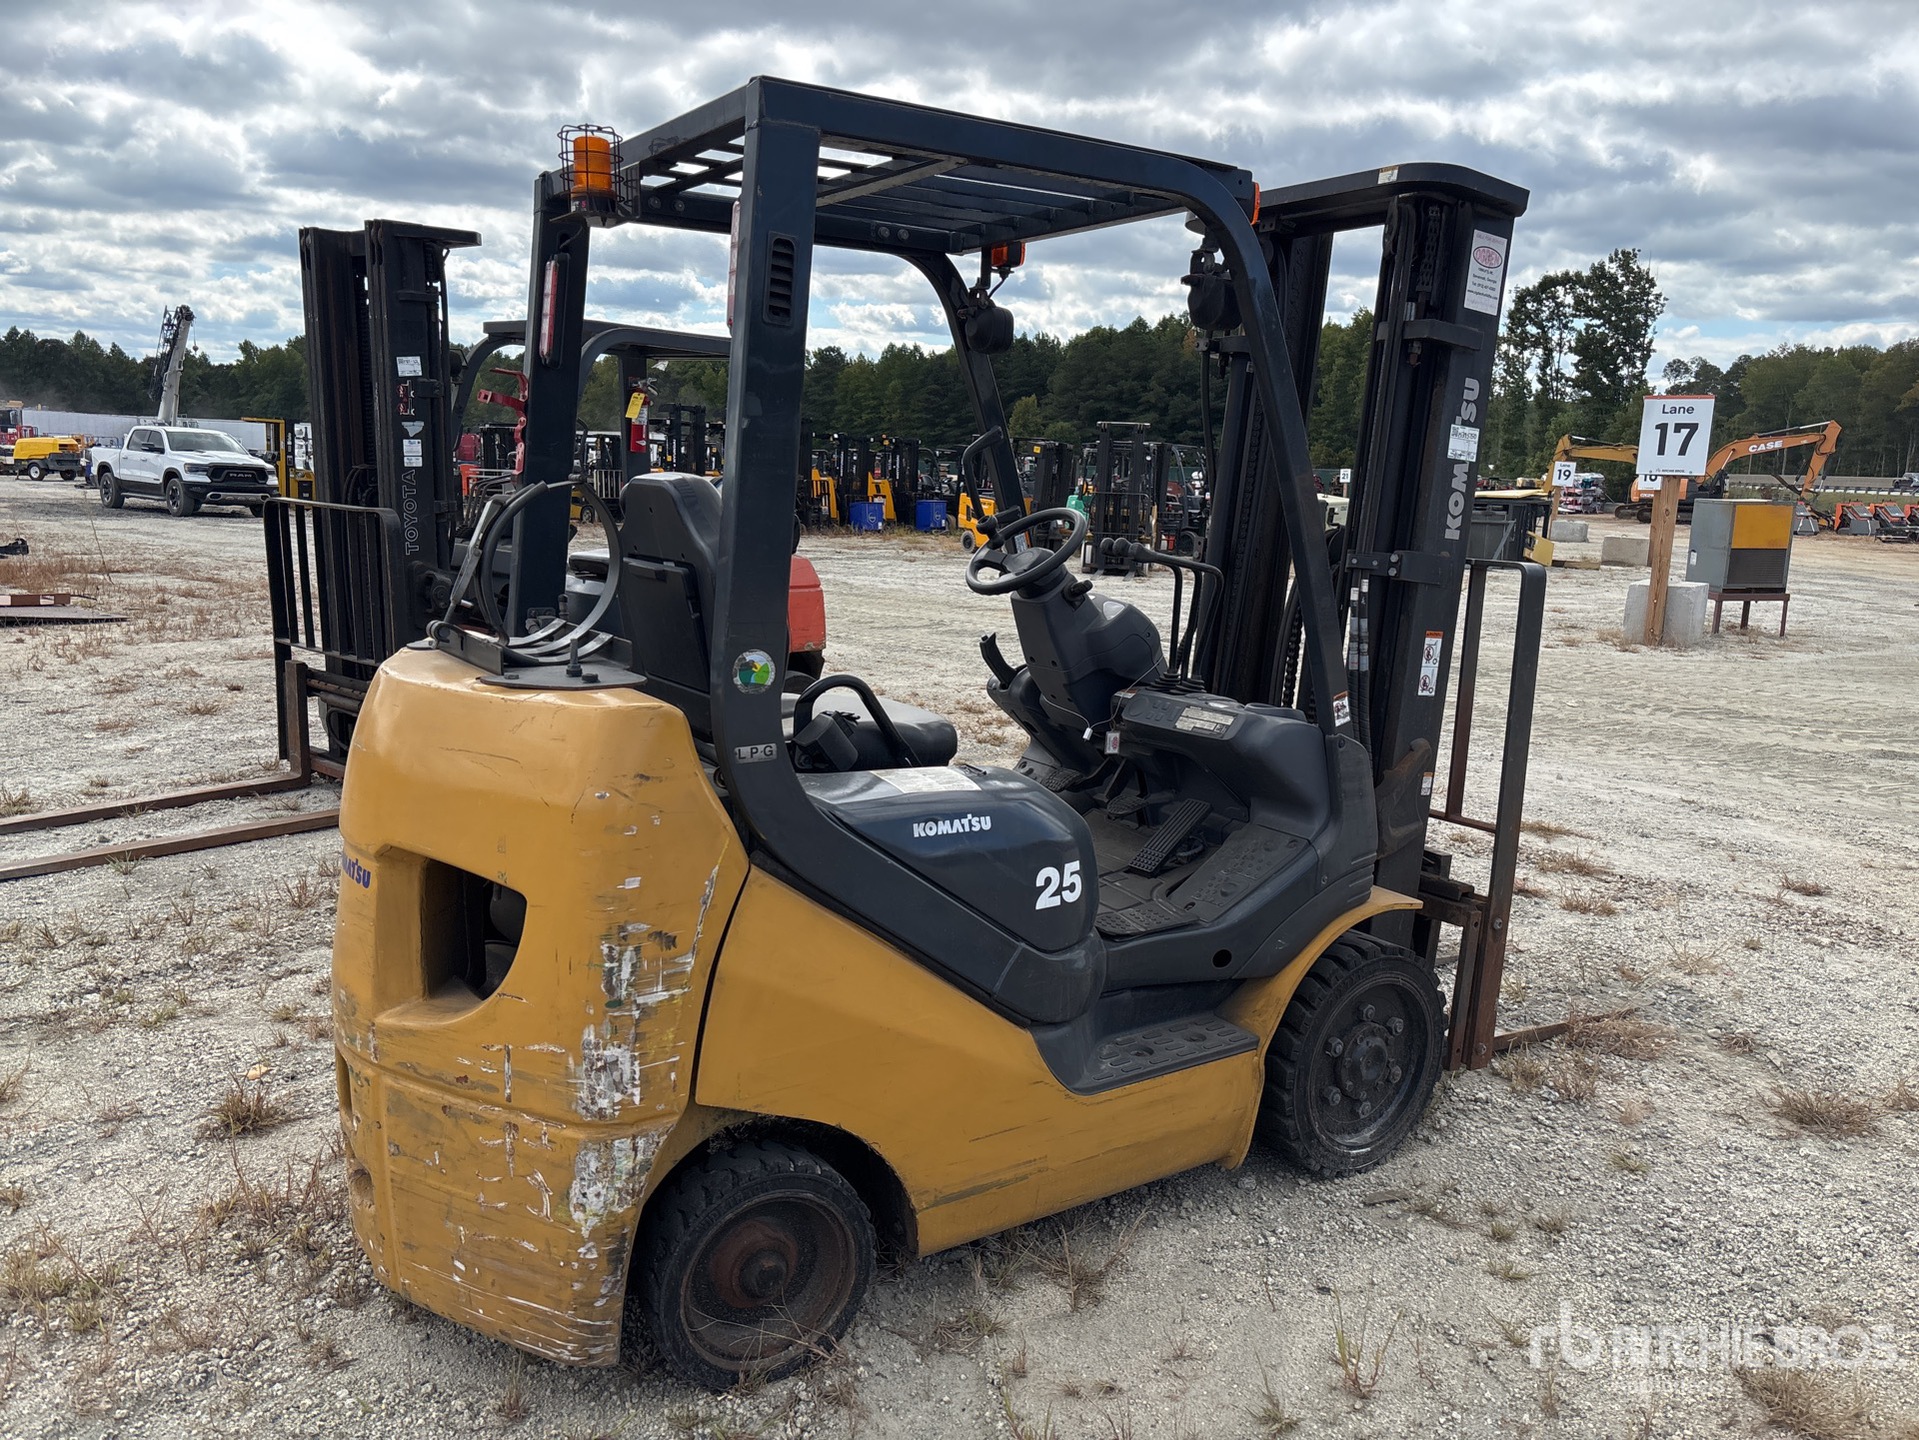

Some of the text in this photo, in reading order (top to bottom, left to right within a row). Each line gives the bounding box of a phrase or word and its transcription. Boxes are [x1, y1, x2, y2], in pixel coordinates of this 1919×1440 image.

[1662, 404, 1695, 414] Lane
[1655, 422, 1699, 456] 17
[1748, 440, 1783, 453] CASE
[1444, 377, 1480, 540] KOMSU
[1557, 469, 1571, 480] 19
[402, 469, 420, 556] TOYOTA
[913, 814, 992, 837] KOMATSU
[1035, 860, 1083, 910] 25
